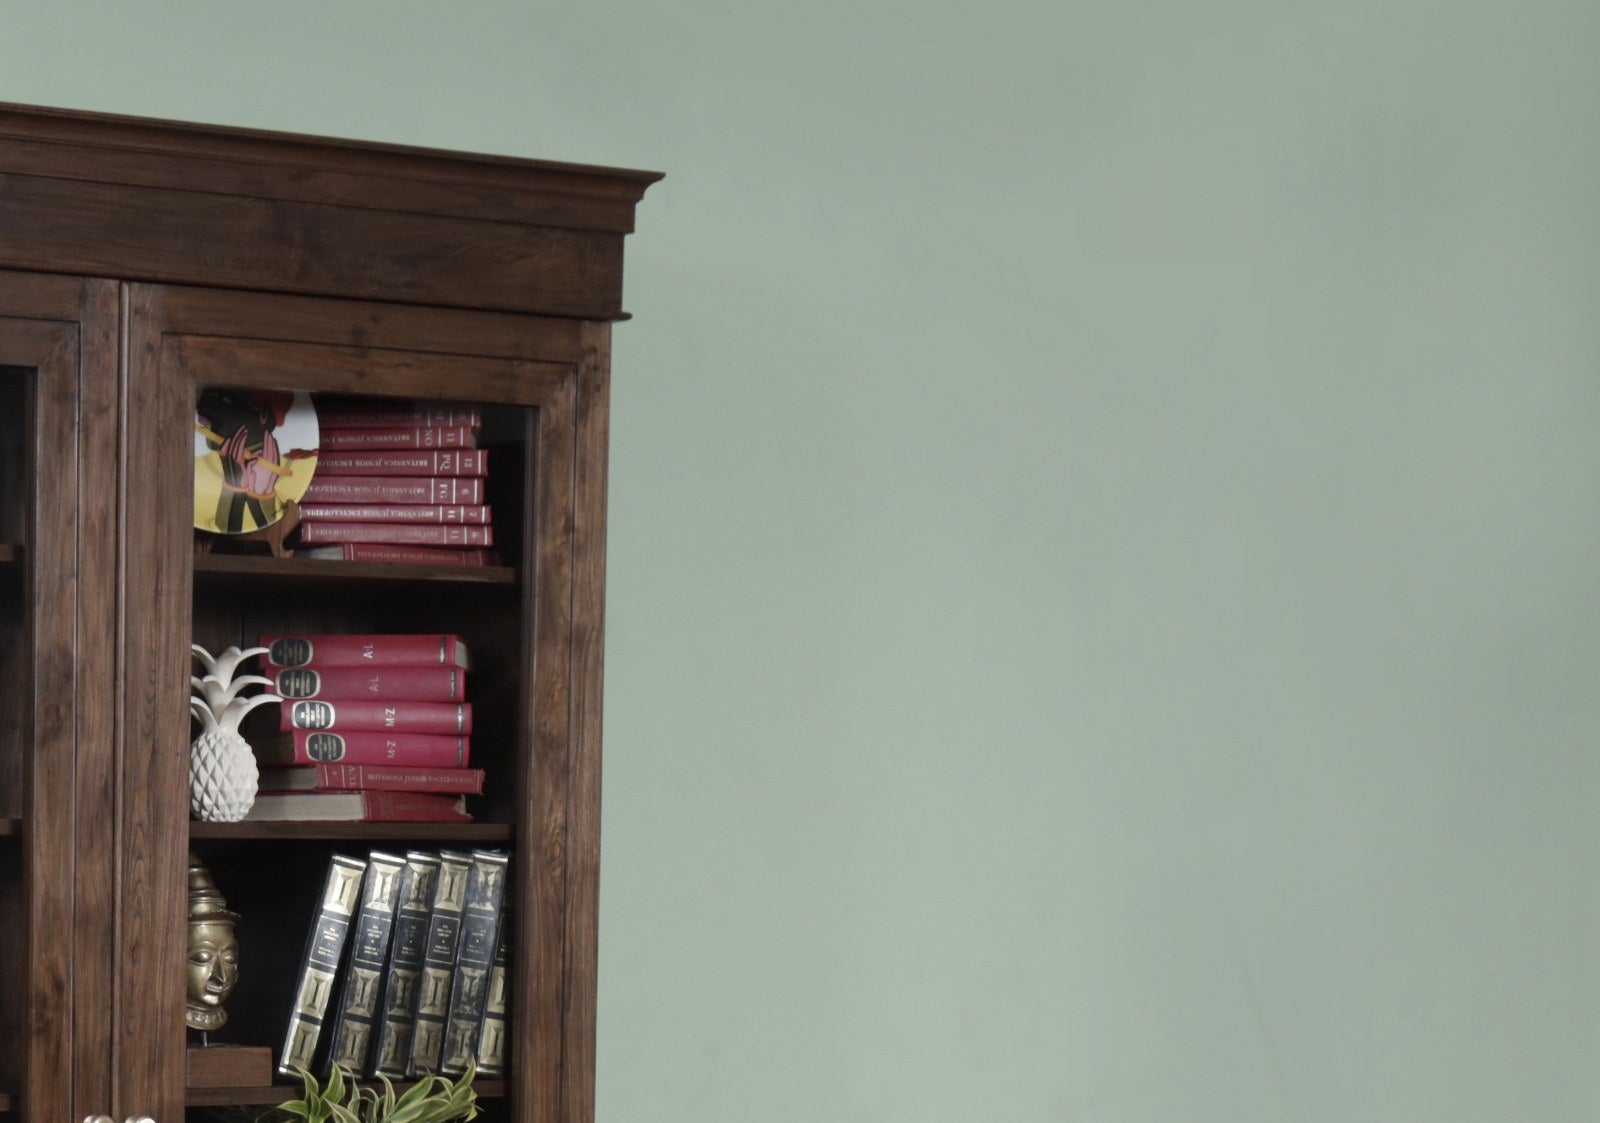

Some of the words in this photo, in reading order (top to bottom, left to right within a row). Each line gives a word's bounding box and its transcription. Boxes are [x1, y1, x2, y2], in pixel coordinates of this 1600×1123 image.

[425, 428, 434, 446] NO
[317, 460, 353, 468] ENCYCLO
[355, 458, 383, 468] JUNIOR
[384, 459, 428, 467] BRITANNICA
[440, 453, 451, 471] PQ
[464, 458, 473, 467] 12
[383, 485, 425, 494] BRITANNICA
[439, 484, 448, 498] FG
[362, 508, 389, 517] JUNIOR
[390, 509, 434, 517] BRITANNICA
